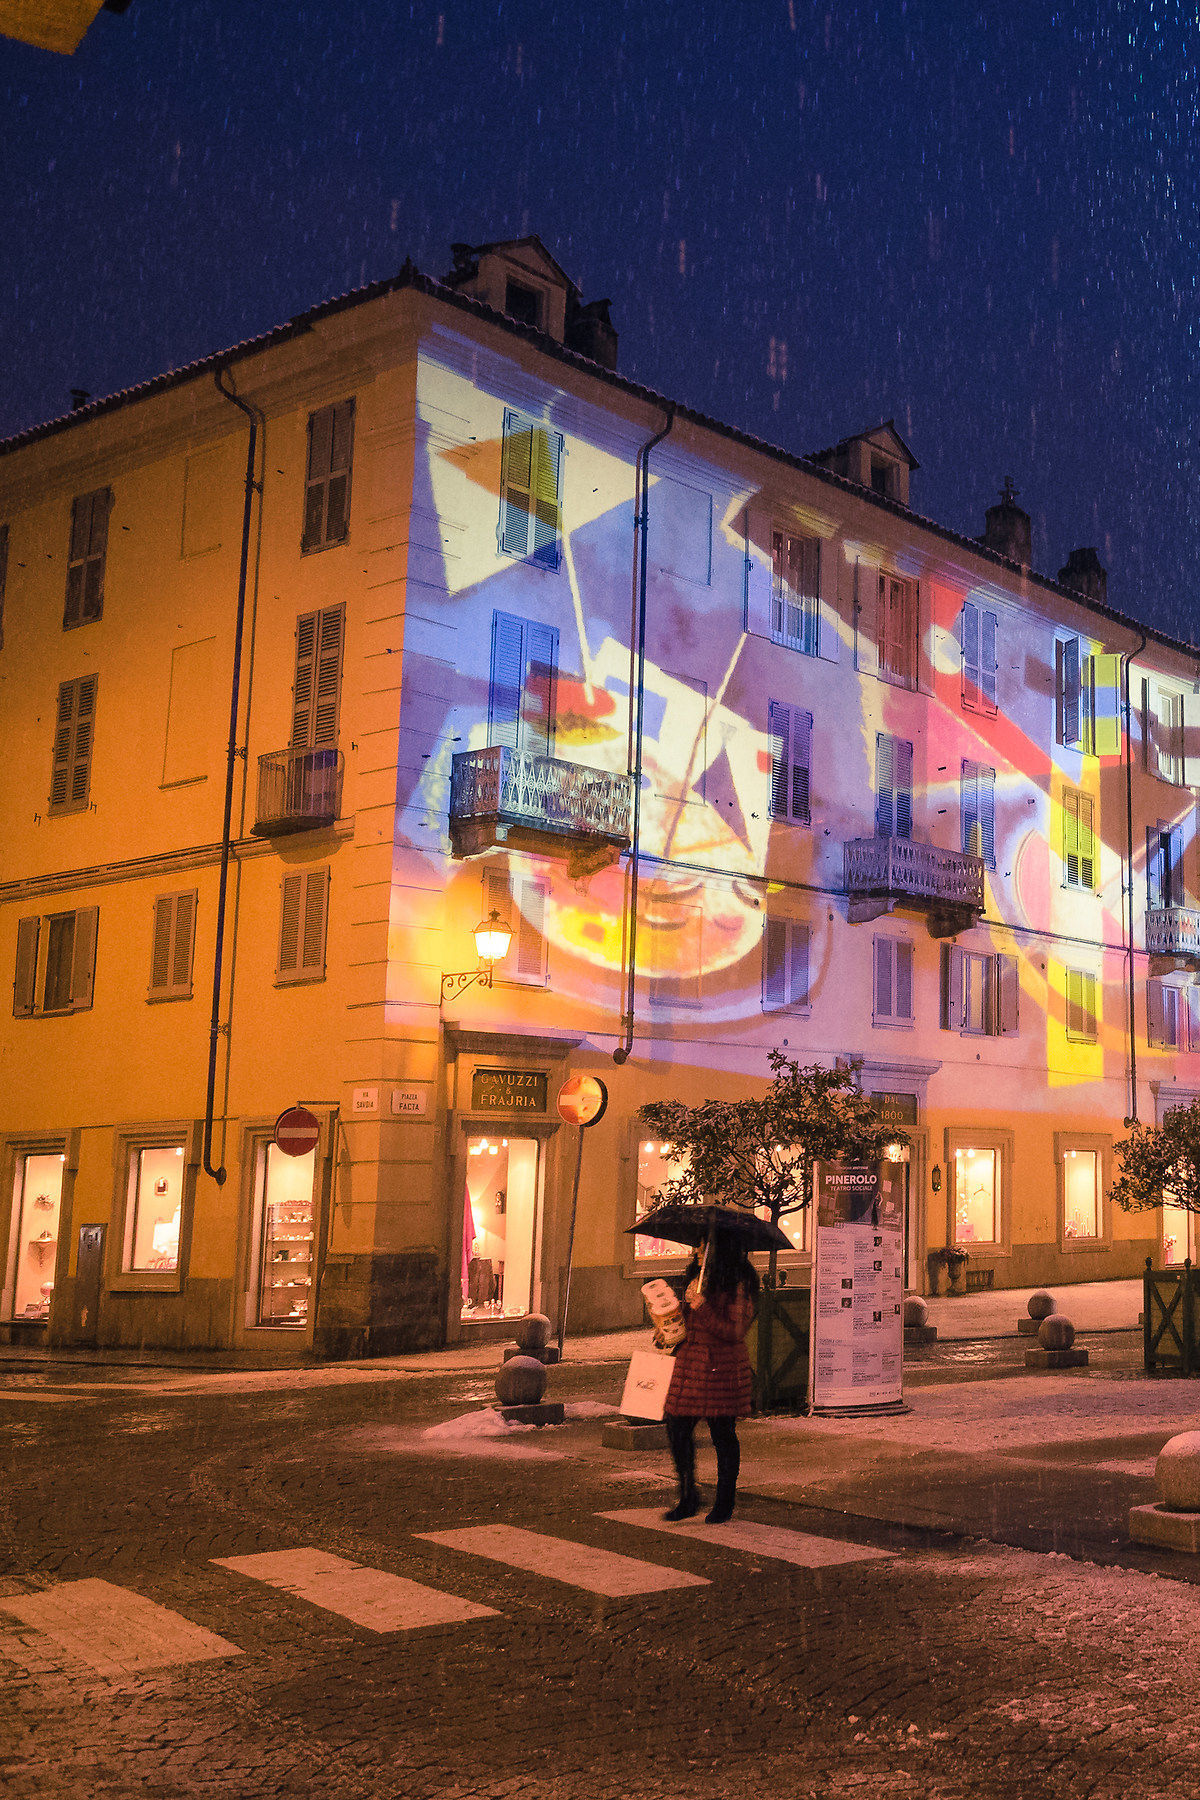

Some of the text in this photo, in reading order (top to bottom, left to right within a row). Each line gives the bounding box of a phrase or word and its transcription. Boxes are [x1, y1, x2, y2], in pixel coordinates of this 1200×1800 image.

[505, 1087, 512, 1095] &
[480, 1094, 537, 1107] FRAJRIA
[884, 1095, 899, 1104] DAL
[399, 1102, 420, 1111] FACTA
[880, 1110, 904, 1120] 1800
[825, 1174, 878, 1185] PINEROLO
